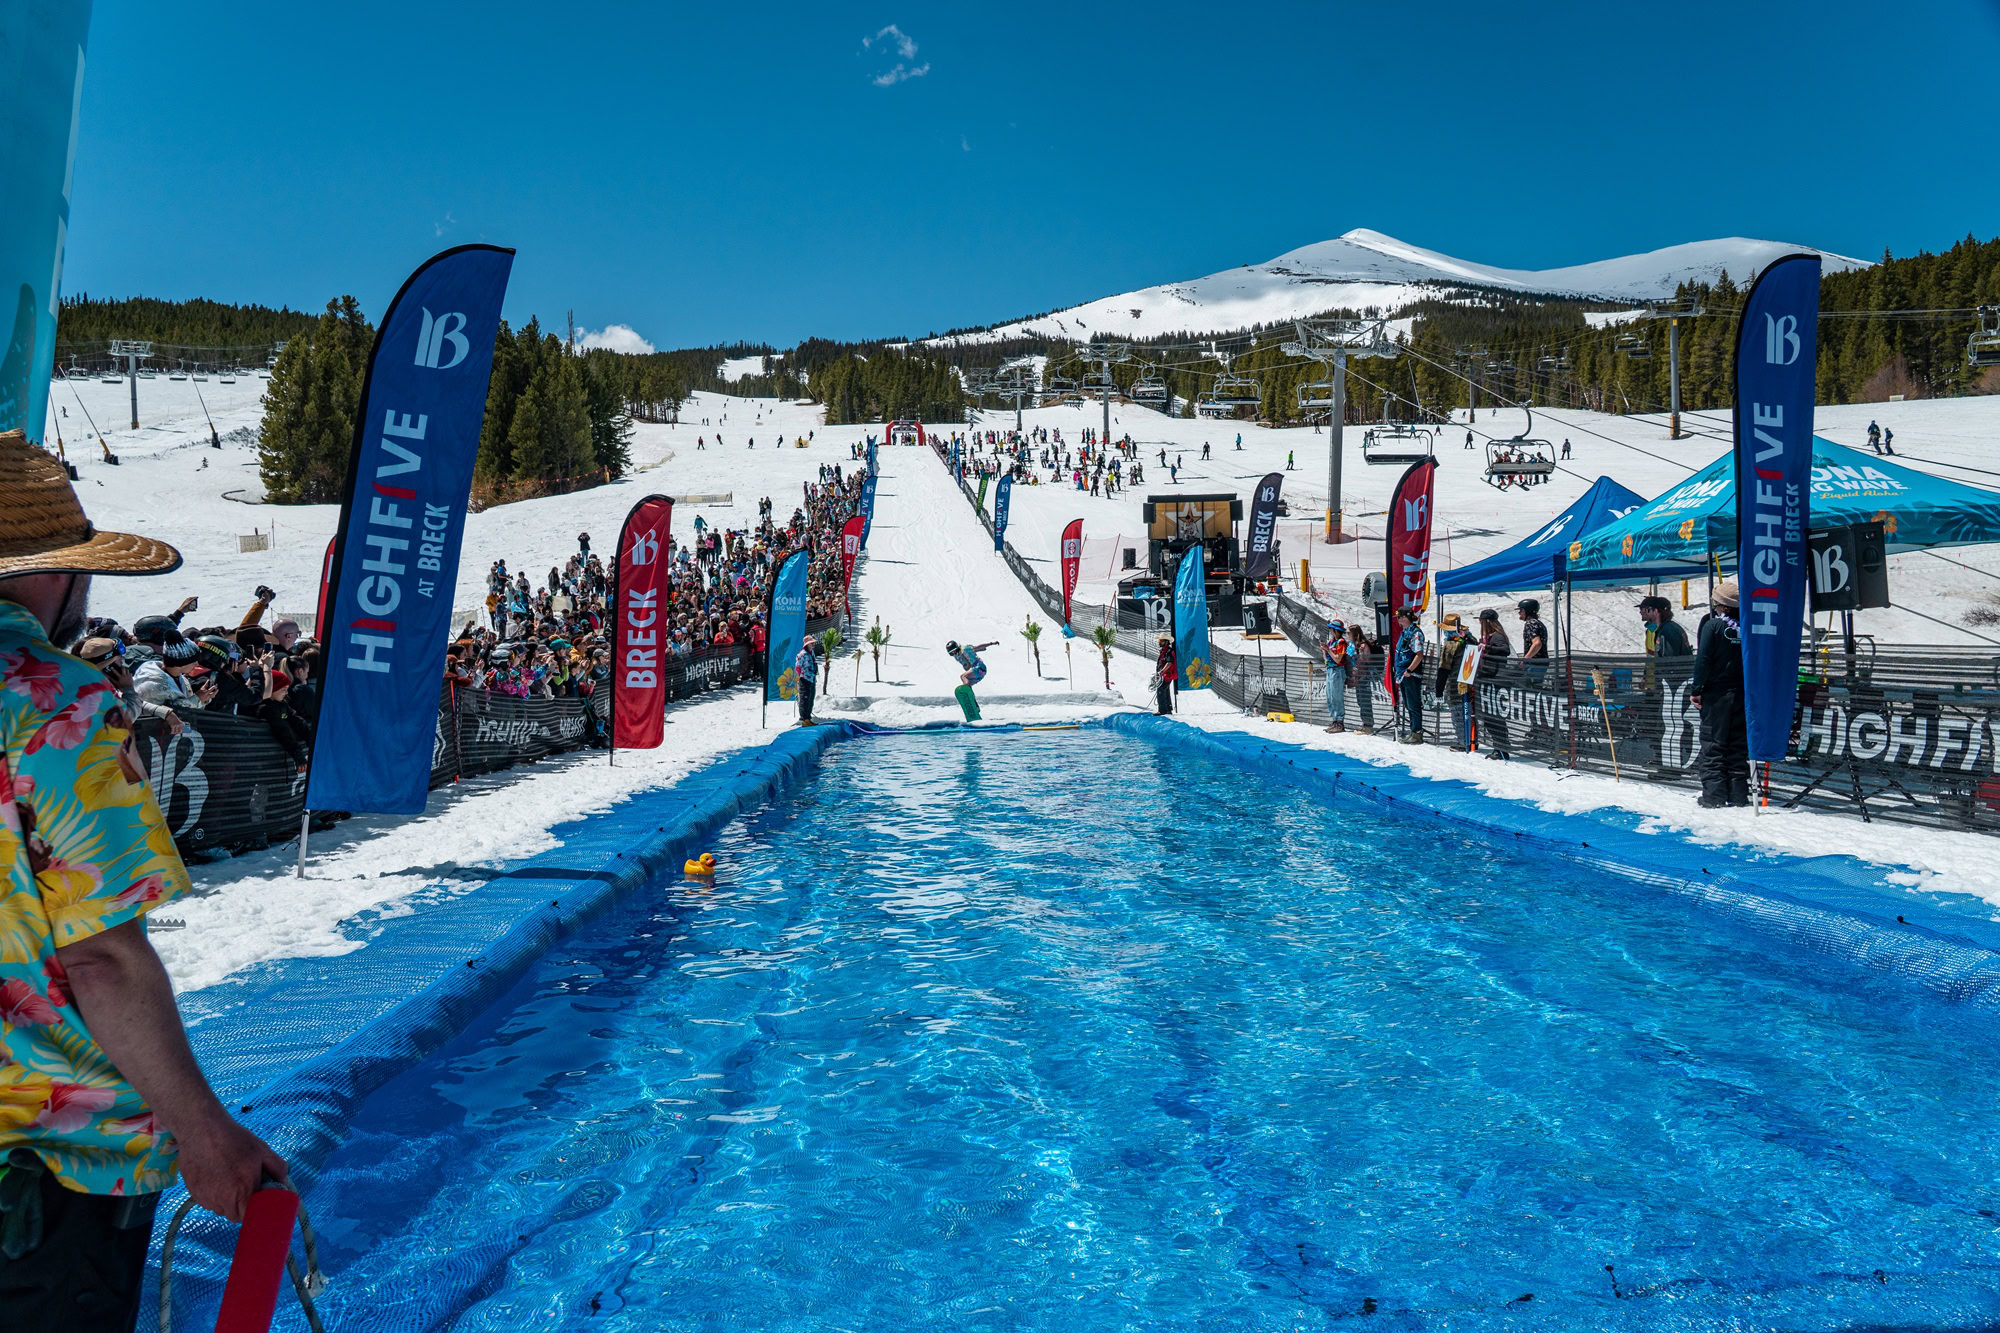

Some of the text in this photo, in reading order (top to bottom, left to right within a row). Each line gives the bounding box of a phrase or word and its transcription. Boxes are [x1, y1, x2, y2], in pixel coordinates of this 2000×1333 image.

[1811, 465, 1894, 481] ONA
[1832, 481, 1909, 491] WAVE
[347, 409, 429, 674] HIGHFIVE
[1253, 511, 1273, 553] BRECK
[1751, 402, 1784, 636] HIGHFIVE
[1784, 482, 1801, 567] AT BRECK
[417, 502, 450, 599] AT BRECK
[1403, 550, 1428, 612] ECK
[626, 587, 658, 689] BRECK
[685, 657, 730, 683] HIGHFIVE
[1479, 683, 1570, 731] HIGHFIVE
[1578, 705, 1600, 723] BRECK
